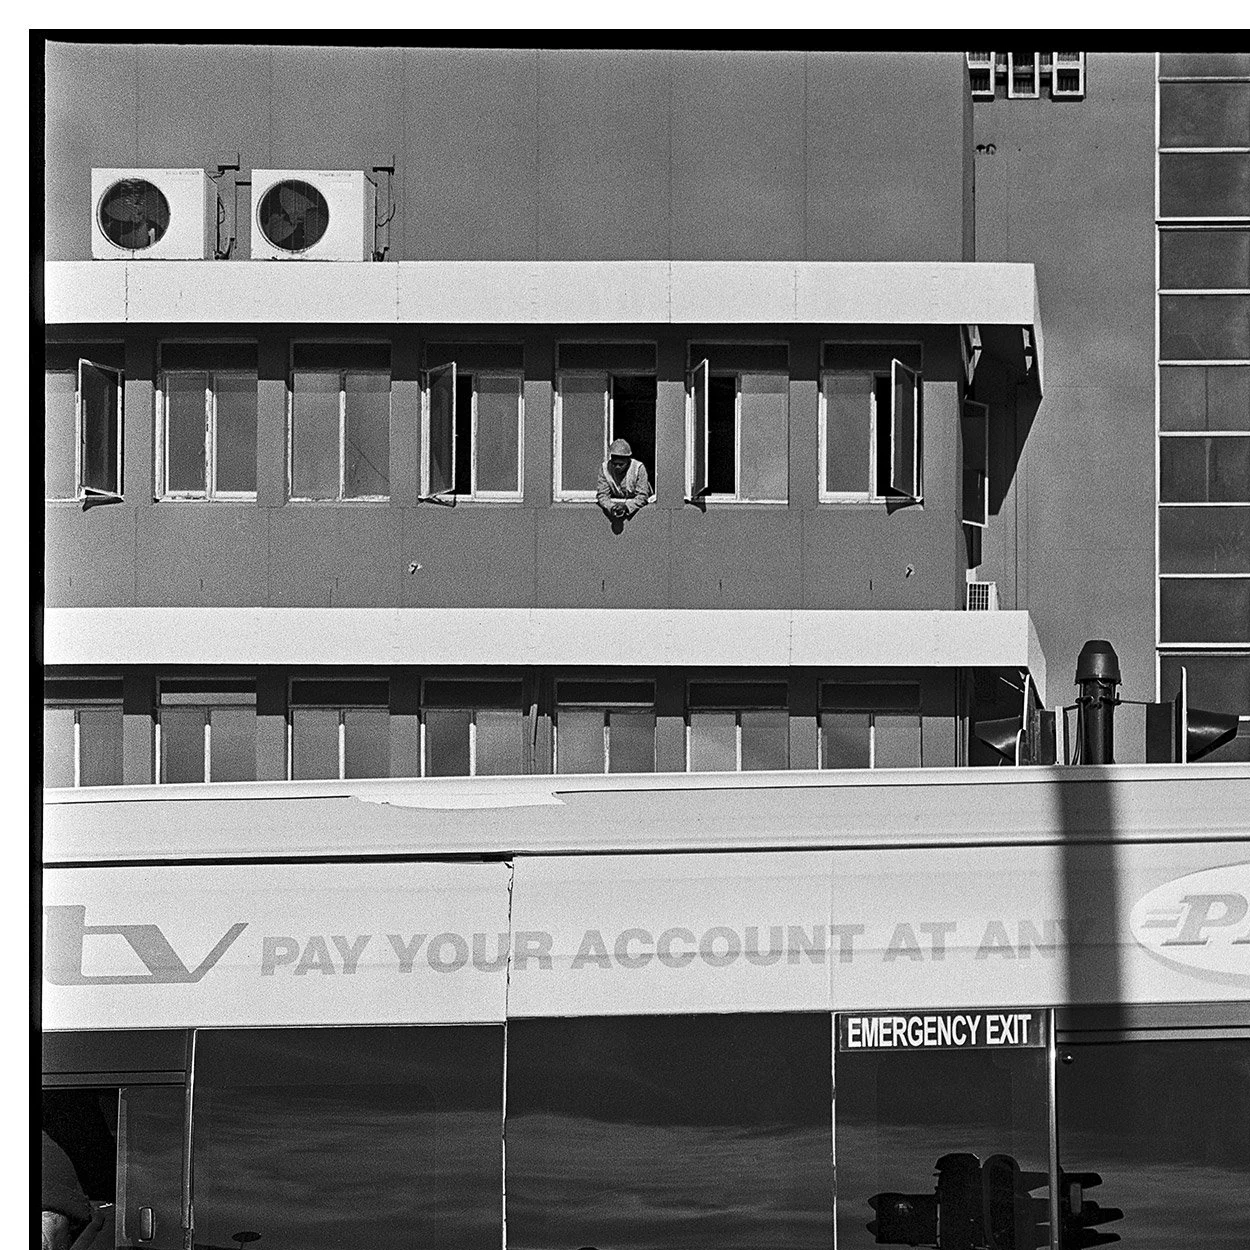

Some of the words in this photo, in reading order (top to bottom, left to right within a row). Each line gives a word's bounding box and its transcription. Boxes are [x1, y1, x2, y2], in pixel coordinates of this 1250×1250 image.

[260, 934, 373, 977] PAY
[386, 931, 554, 973] YOUR
[570, 923, 866, 969] ACCOUNT
[882, 921, 957, 962] AT
[847, 1014, 982, 1048] EMERGENCY
[986, 1013, 1032, 1045] EXIT
